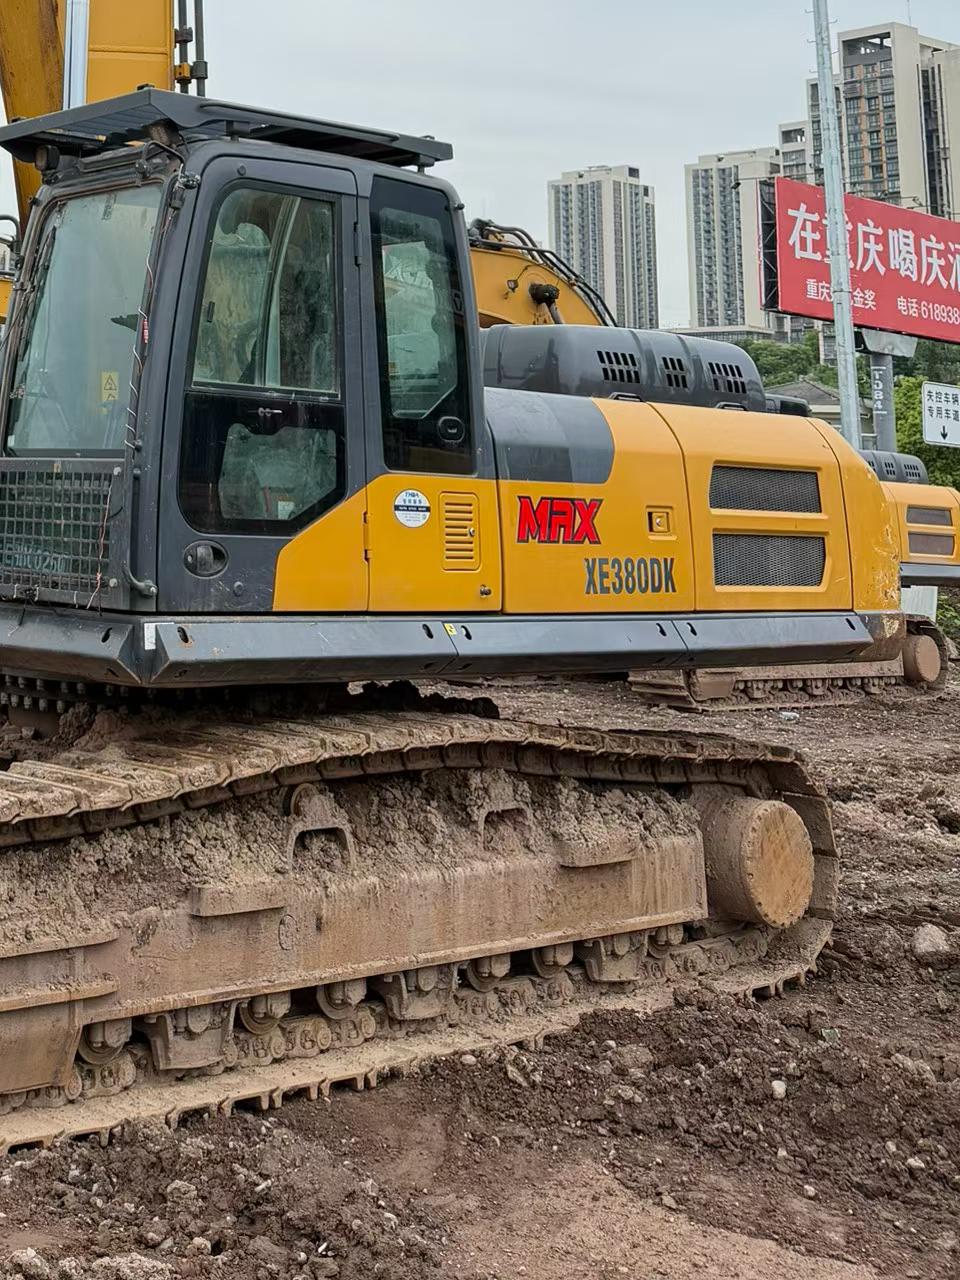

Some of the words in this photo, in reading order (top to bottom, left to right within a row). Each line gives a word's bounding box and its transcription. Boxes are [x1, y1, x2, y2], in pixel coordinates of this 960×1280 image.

[787, 202, 960, 293] 在庆喝庆
[806, 278, 877, 311] 重庆金奖
[517, 495, 604, 545] MAX
[584, 557, 677, 595] XE380DK
